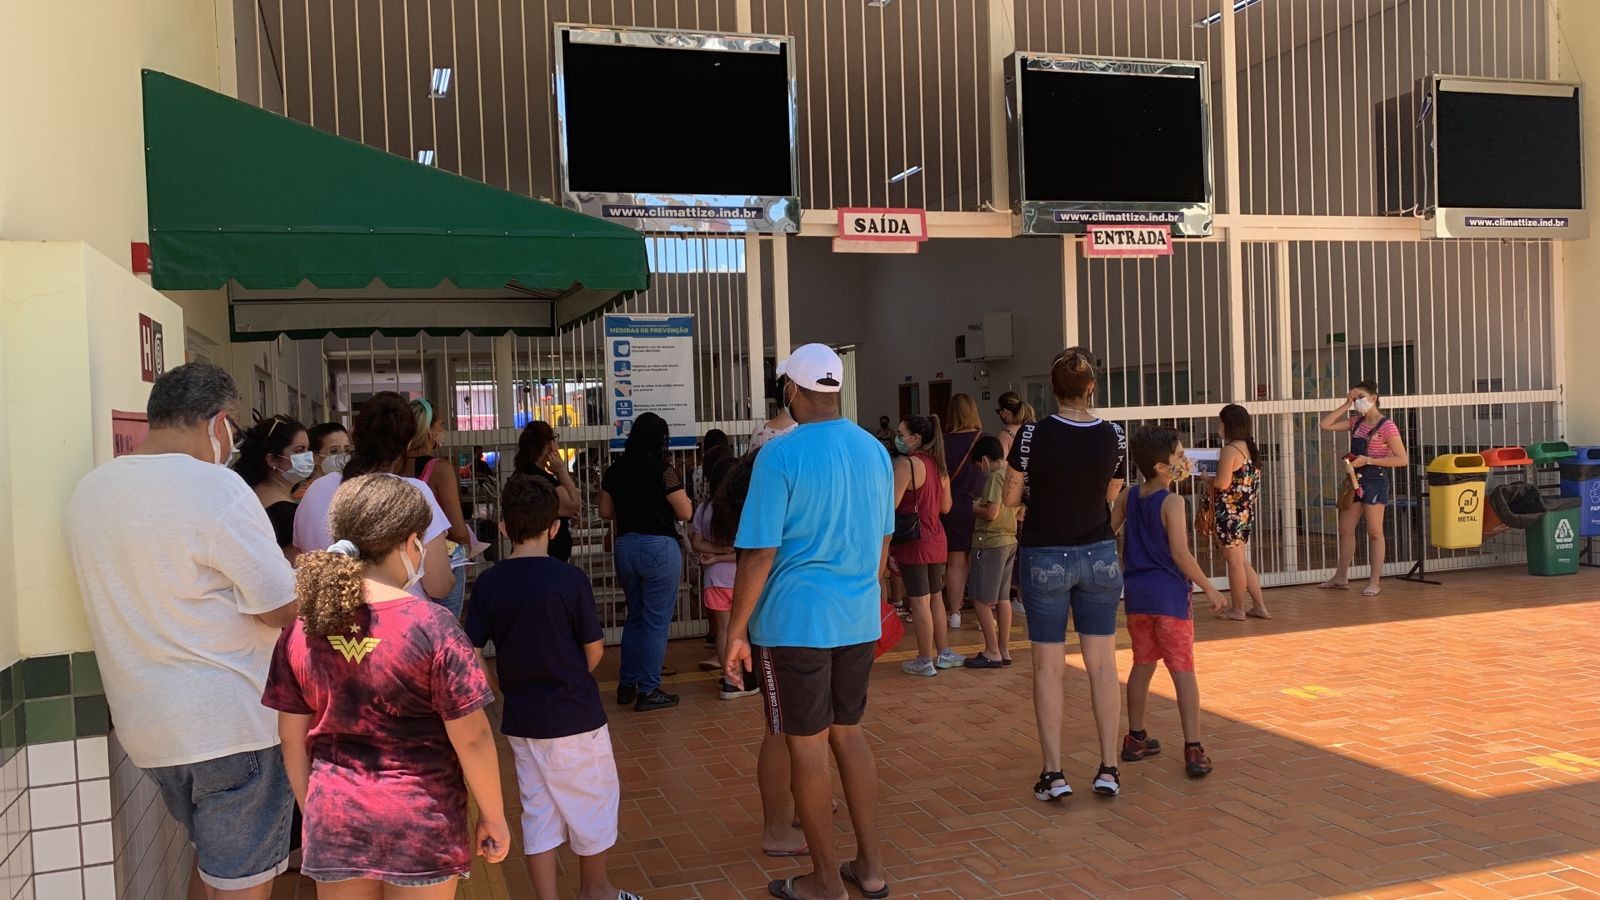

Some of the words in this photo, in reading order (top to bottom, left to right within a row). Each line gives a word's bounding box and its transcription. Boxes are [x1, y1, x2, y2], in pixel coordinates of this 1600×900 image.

[609, 207, 756, 218] www.climattize.ind.br
[1060, 212, 1179, 222] www.climattize.ind.br
[854, 214, 911, 234] SAÍDA
[1469, 218, 1565, 227] www.climattize.ind.br
[1093, 230, 1167, 246] ENTRADA
[650, 326, 689, 335] PREVENÇÃO
[1020, 424, 1035, 454] POLO
[766, 670, 776, 691] URBAN
